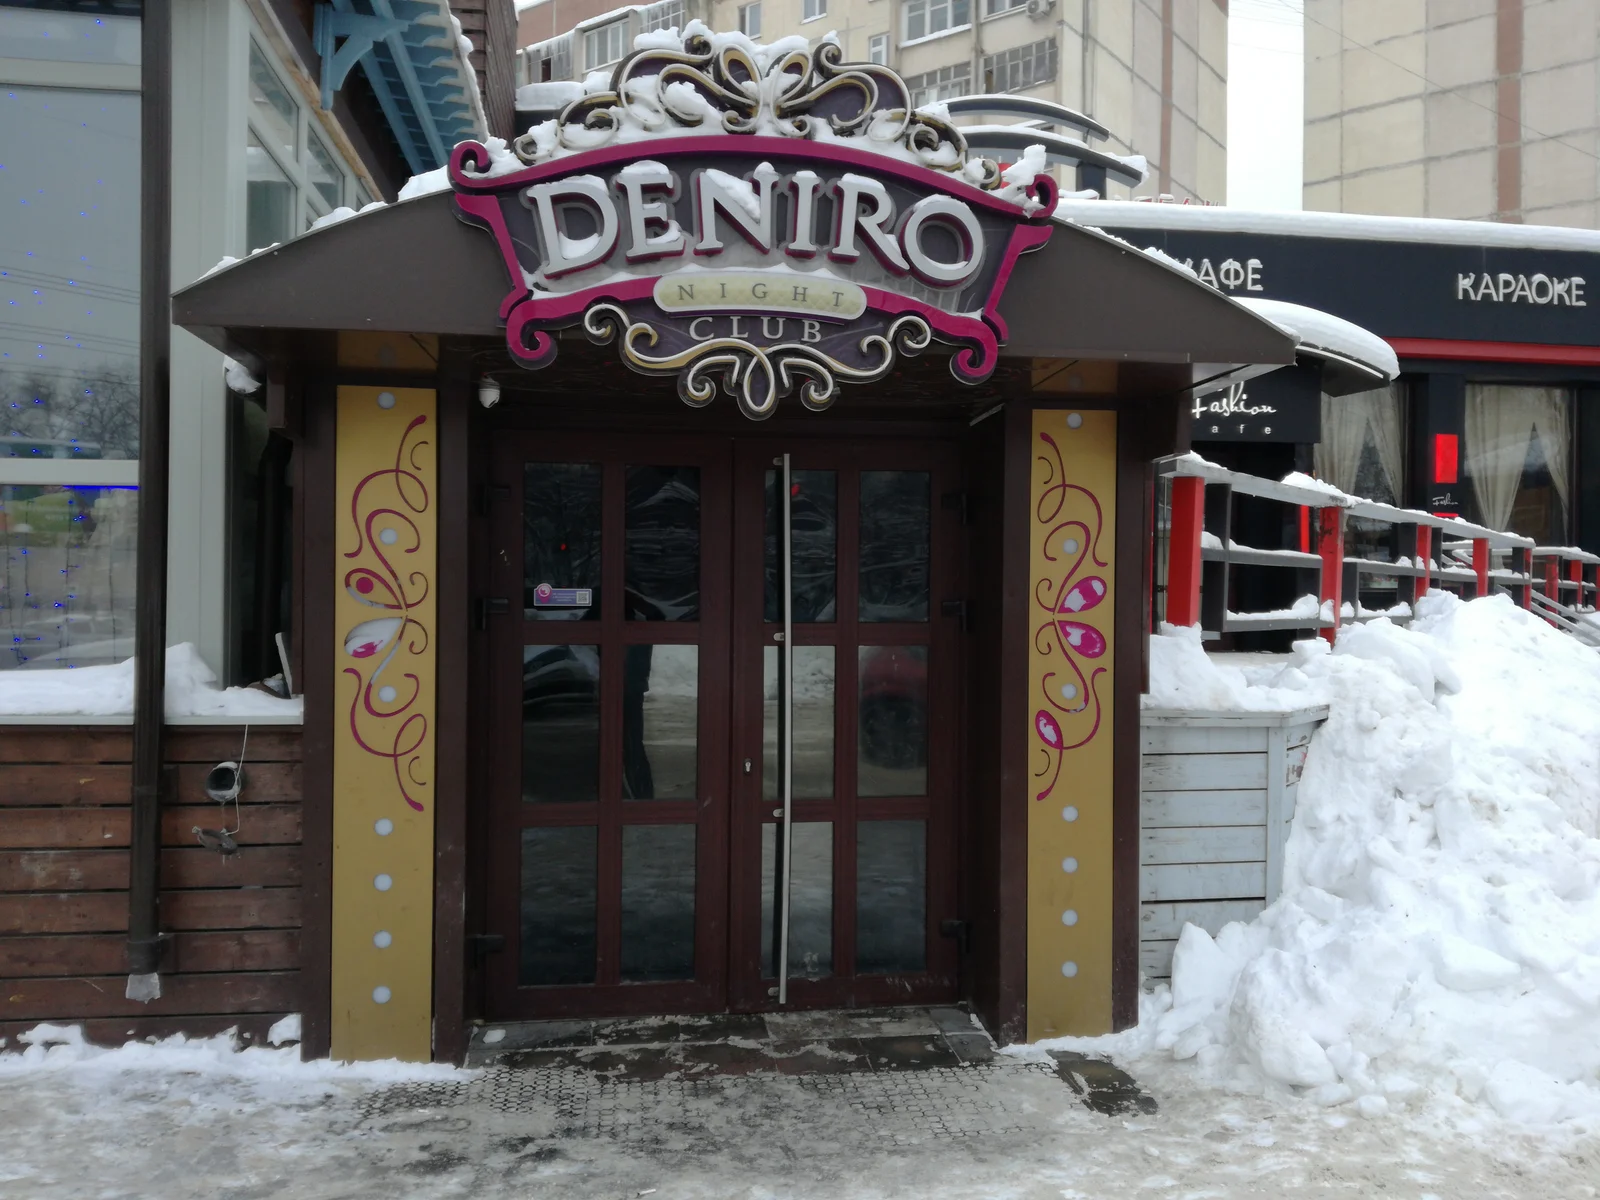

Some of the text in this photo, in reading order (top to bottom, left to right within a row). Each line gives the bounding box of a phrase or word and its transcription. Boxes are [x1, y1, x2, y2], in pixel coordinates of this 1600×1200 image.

[528, 162, 984, 283] DENIRO
[677, 282, 844, 307] NIGHT
[1458, 272, 1587, 306] КАРАОКЕ
[688, 316, 822, 343] CLUB
[1211, 424, 1272, 435] afe
